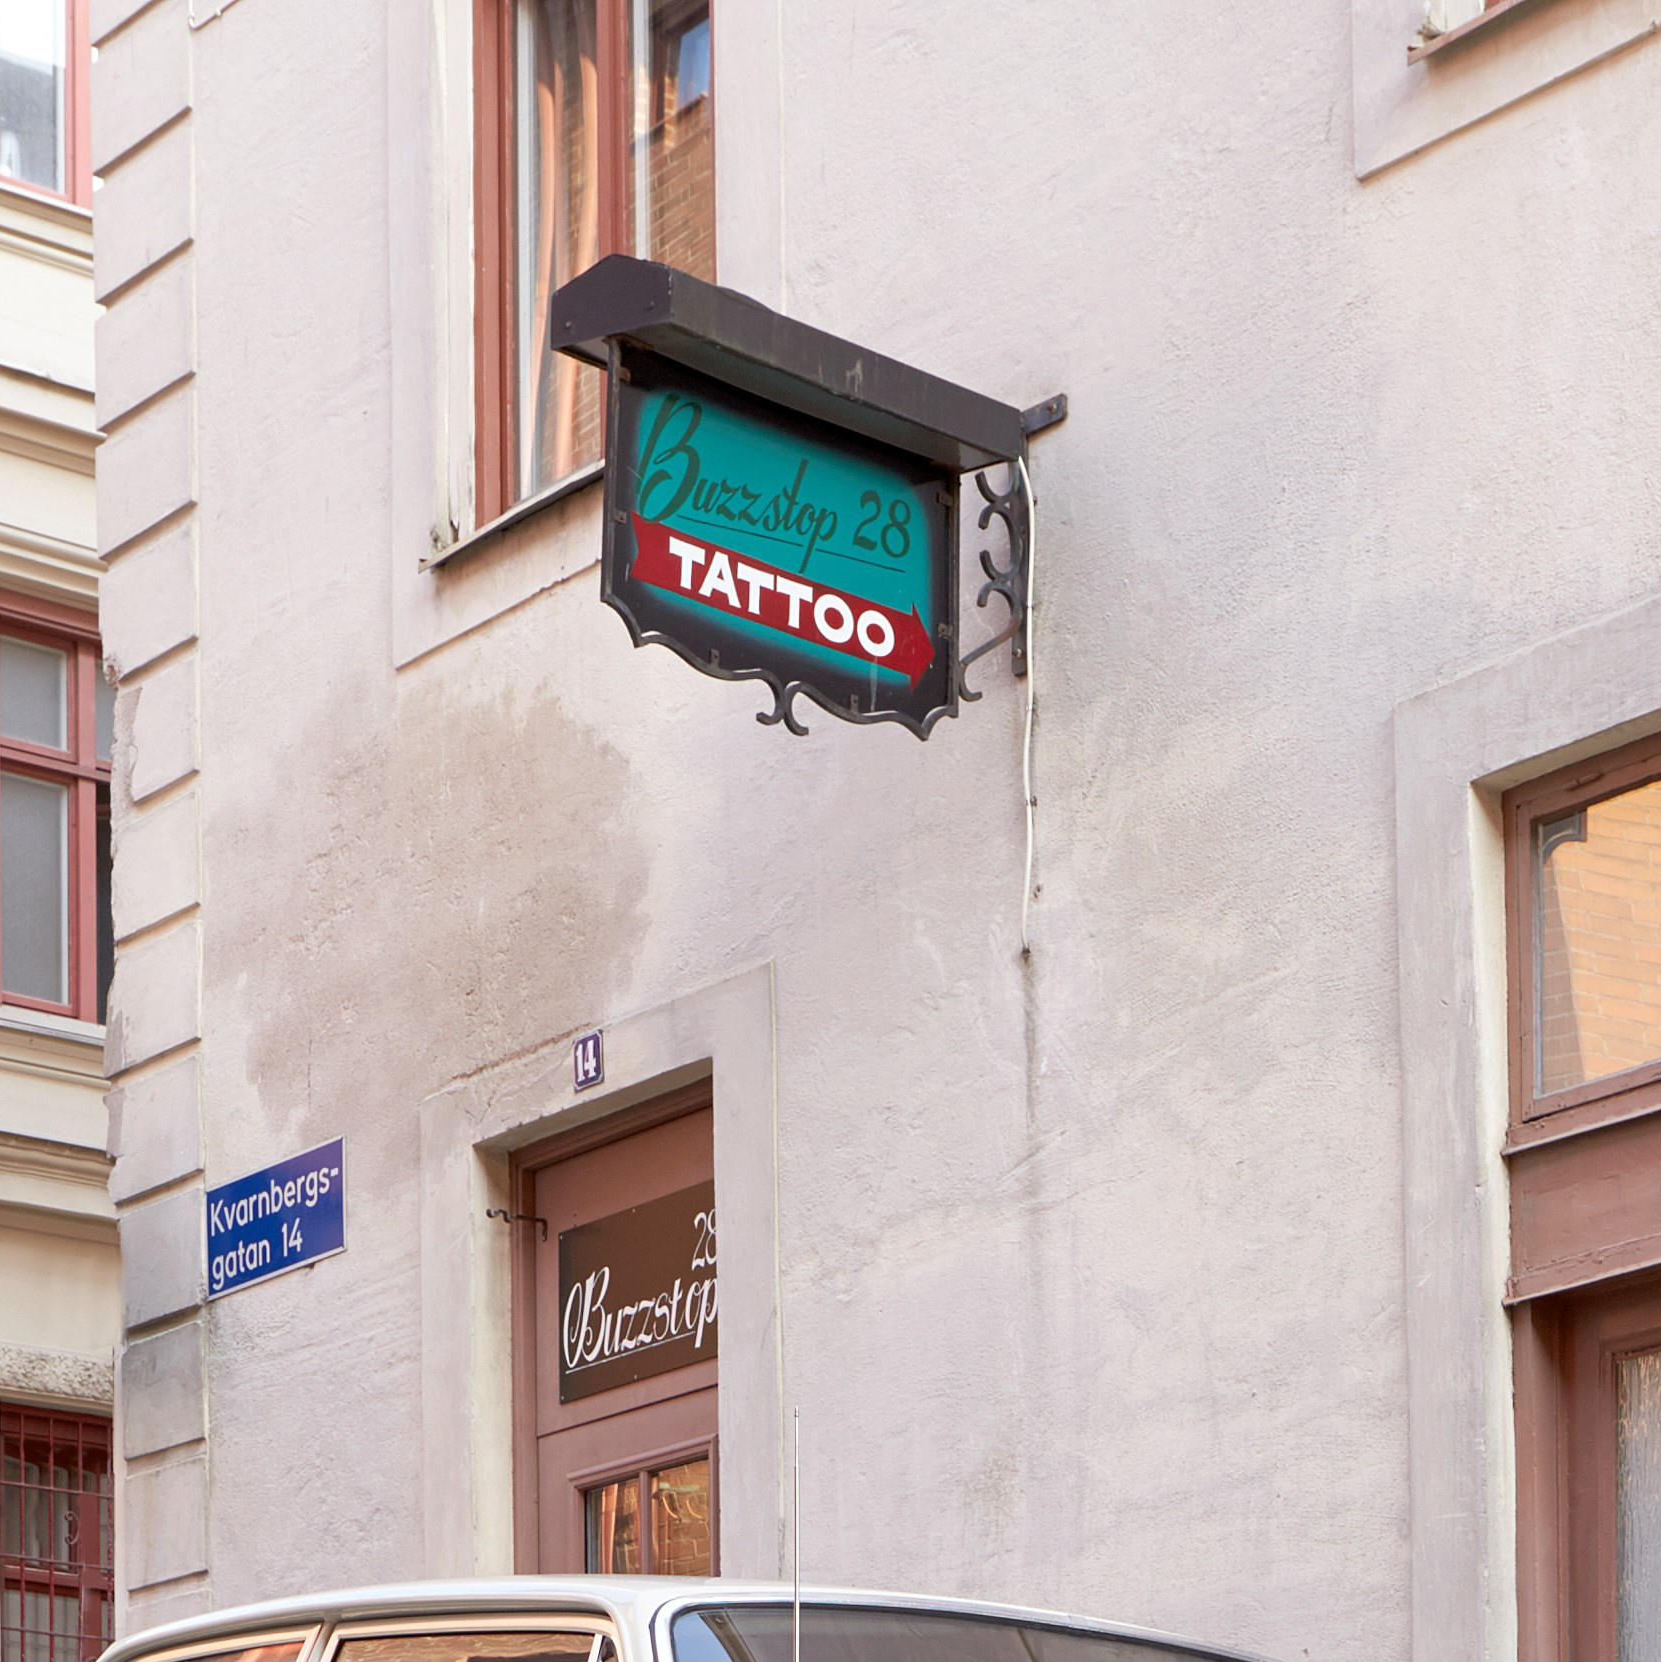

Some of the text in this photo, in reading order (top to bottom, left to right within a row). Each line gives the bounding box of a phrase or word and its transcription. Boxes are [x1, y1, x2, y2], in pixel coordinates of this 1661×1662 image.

[637, 392, 912, 575] Buzzstop 28
[668, 535, 896, 658] TATTOO
[575, 1039, 597, 1083] 14
[210, 1166, 339, 1237] Kvarnbergs-
[212, 1217, 304, 1291] gatan 14
[691, 1207, 717, 1271] 28
[563, 1265, 719, 1369] Buzzstop
